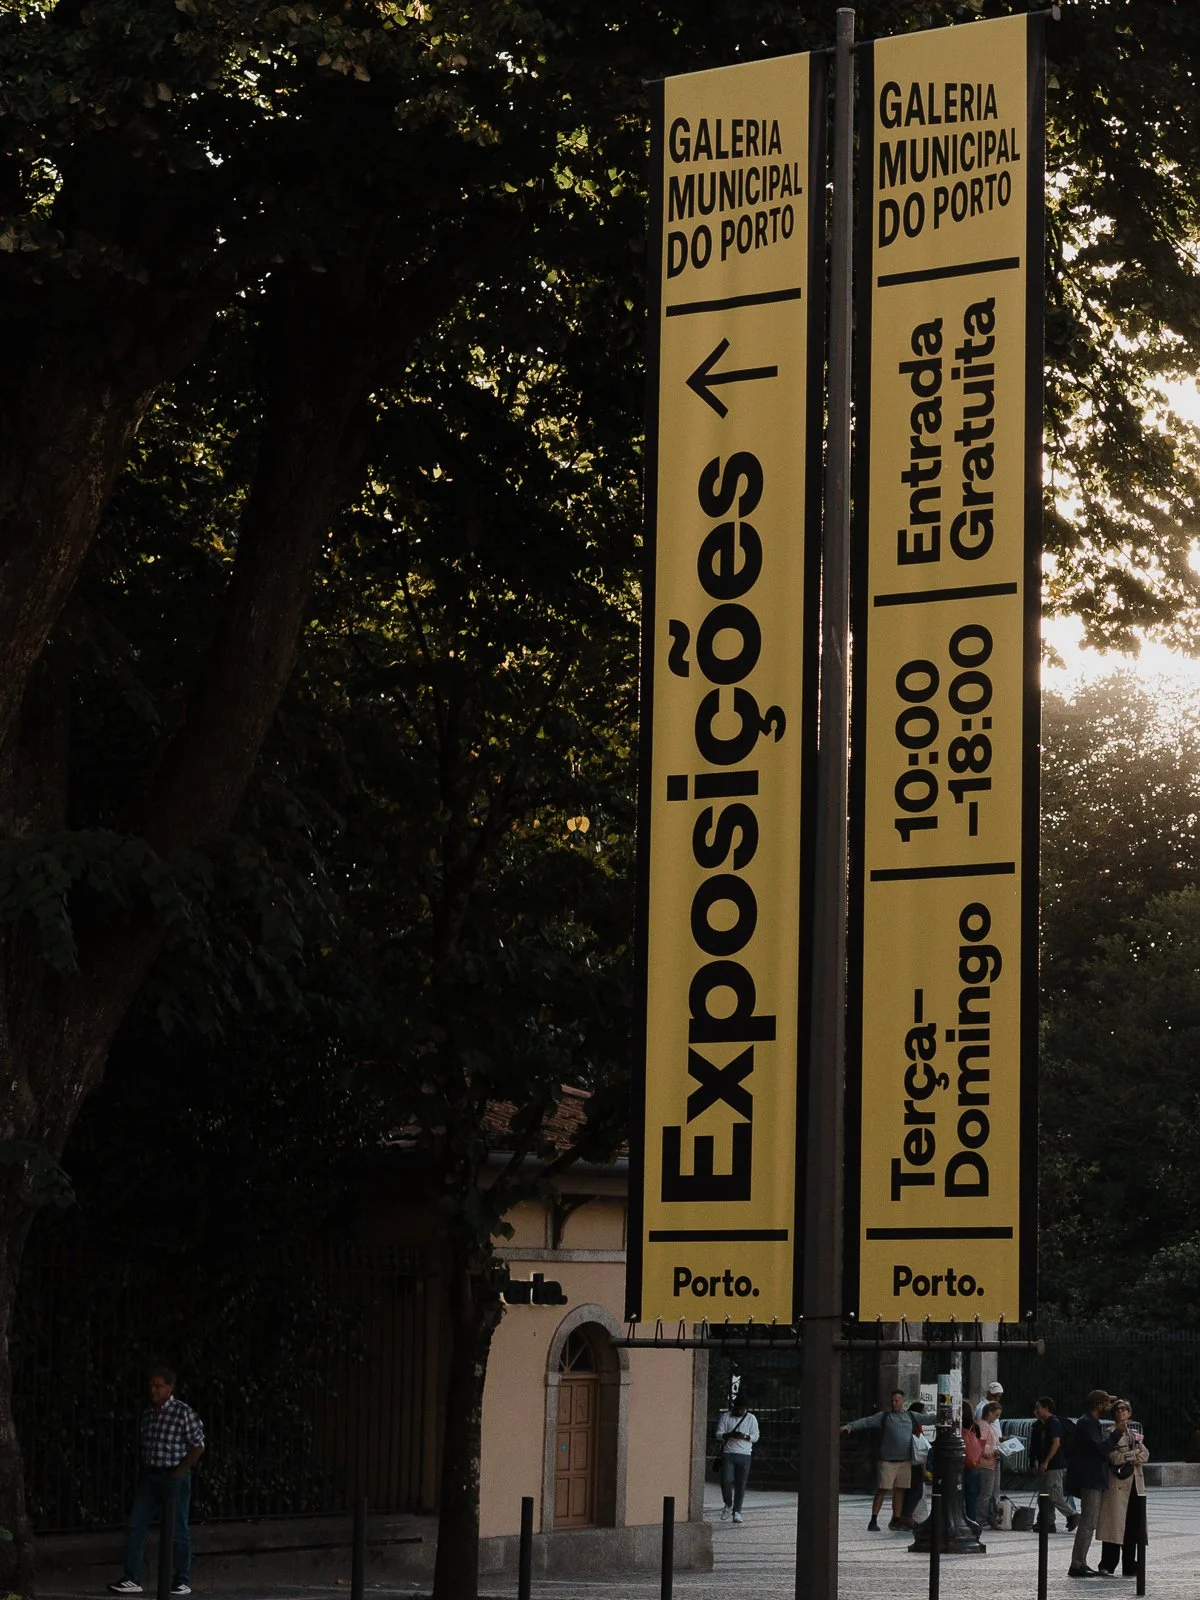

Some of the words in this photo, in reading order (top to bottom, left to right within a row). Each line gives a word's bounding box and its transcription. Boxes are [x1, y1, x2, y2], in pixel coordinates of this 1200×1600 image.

[669, 118, 781, 163] GALERIA
[880, 81, 997, 129] GALERIA
[669, 163, 802, 222] MUNICIPAL
[879, 128, 1020, 190] MUNICIPAL
[667, 225, 712, 279] DO
[721, 204, 793, 261] PORTO
[879, 192, 925, 248] DO
[934, 171, 1011, 229] PORTO
[897, 318, 943, 565] Entrada
[950, 297, 995, 560] Gratuita
[895, 660, 939, 842] 10:00
[661, 452, 786, 1202] Exposições
[945, 903, 1002, 1197] Domingo
[674, 1267, 759, 1297] Porto.
[894, 1266, 984, 1296] Porto.
